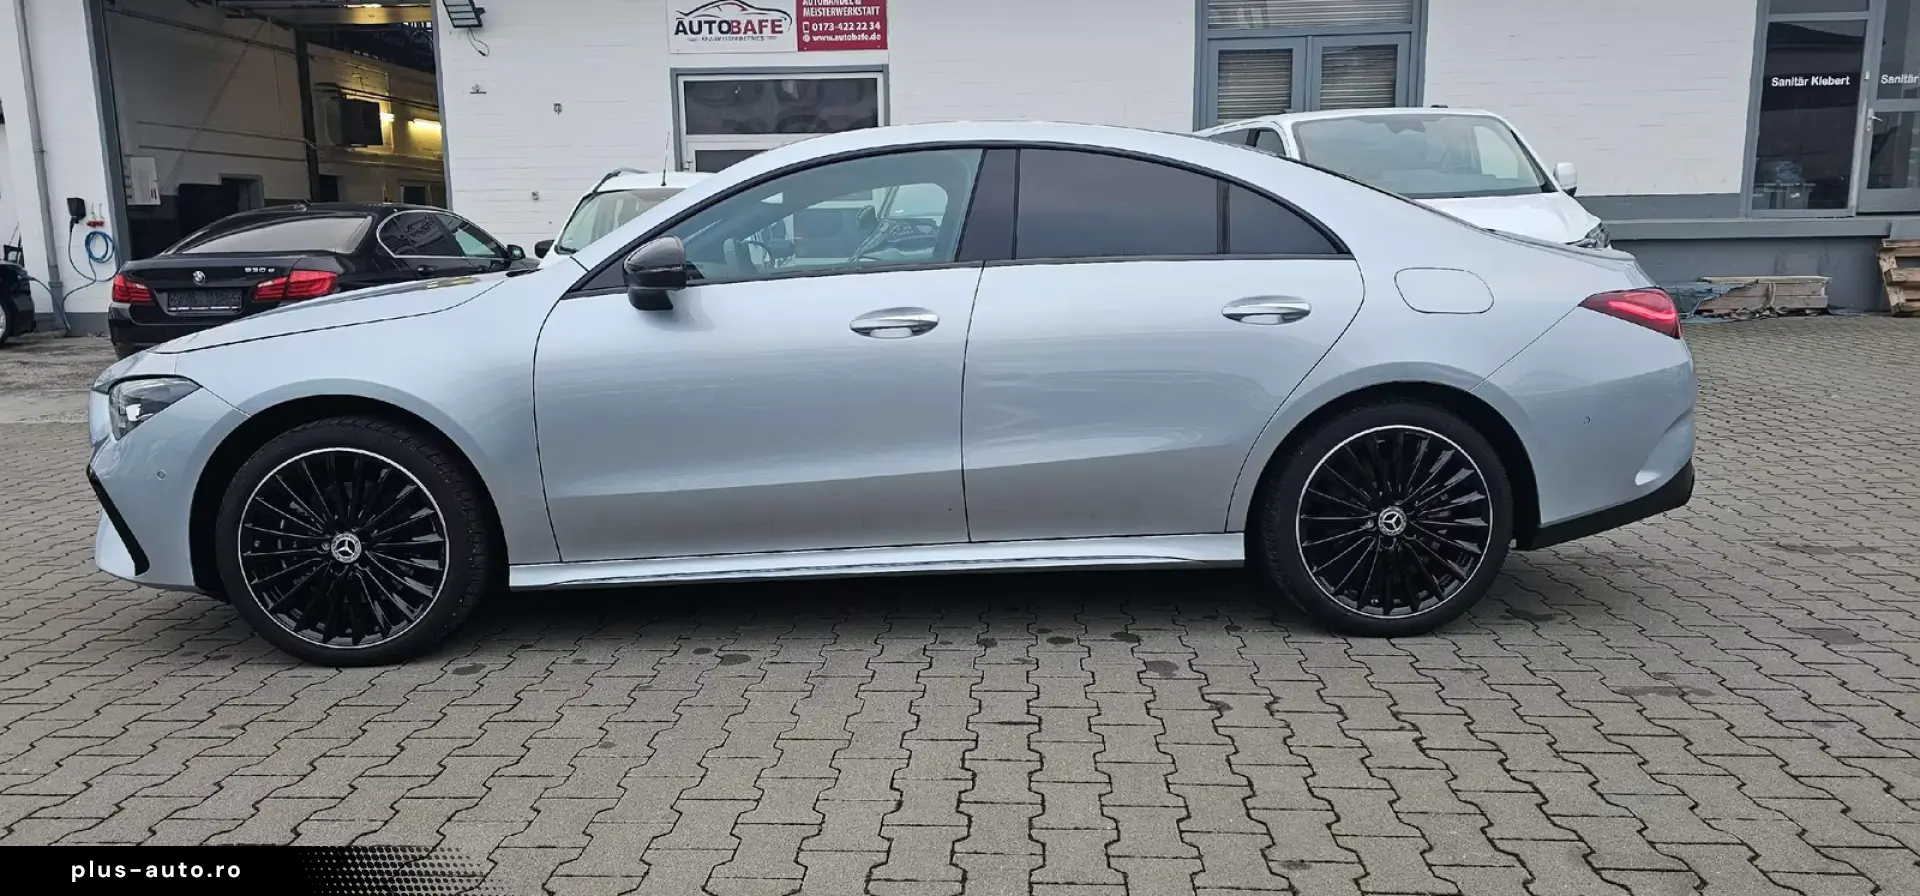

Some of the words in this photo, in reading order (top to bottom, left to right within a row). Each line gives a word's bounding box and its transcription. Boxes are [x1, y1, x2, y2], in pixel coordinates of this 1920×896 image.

[803, 6, 880, 17] MEISTERWERKSTATT
[674, 19, 784, 35] AUTOBAFE
[812, 23, 854, 31] 0173-422
[856, 22, 868, 31] 22
[869, 21, 881, 30] 34
[812, 33, 881, 41] www.autobafe.de
[1771, 77, 1808, 87] Sanitär
[1880, 74, 1919, 84] Sanitär
